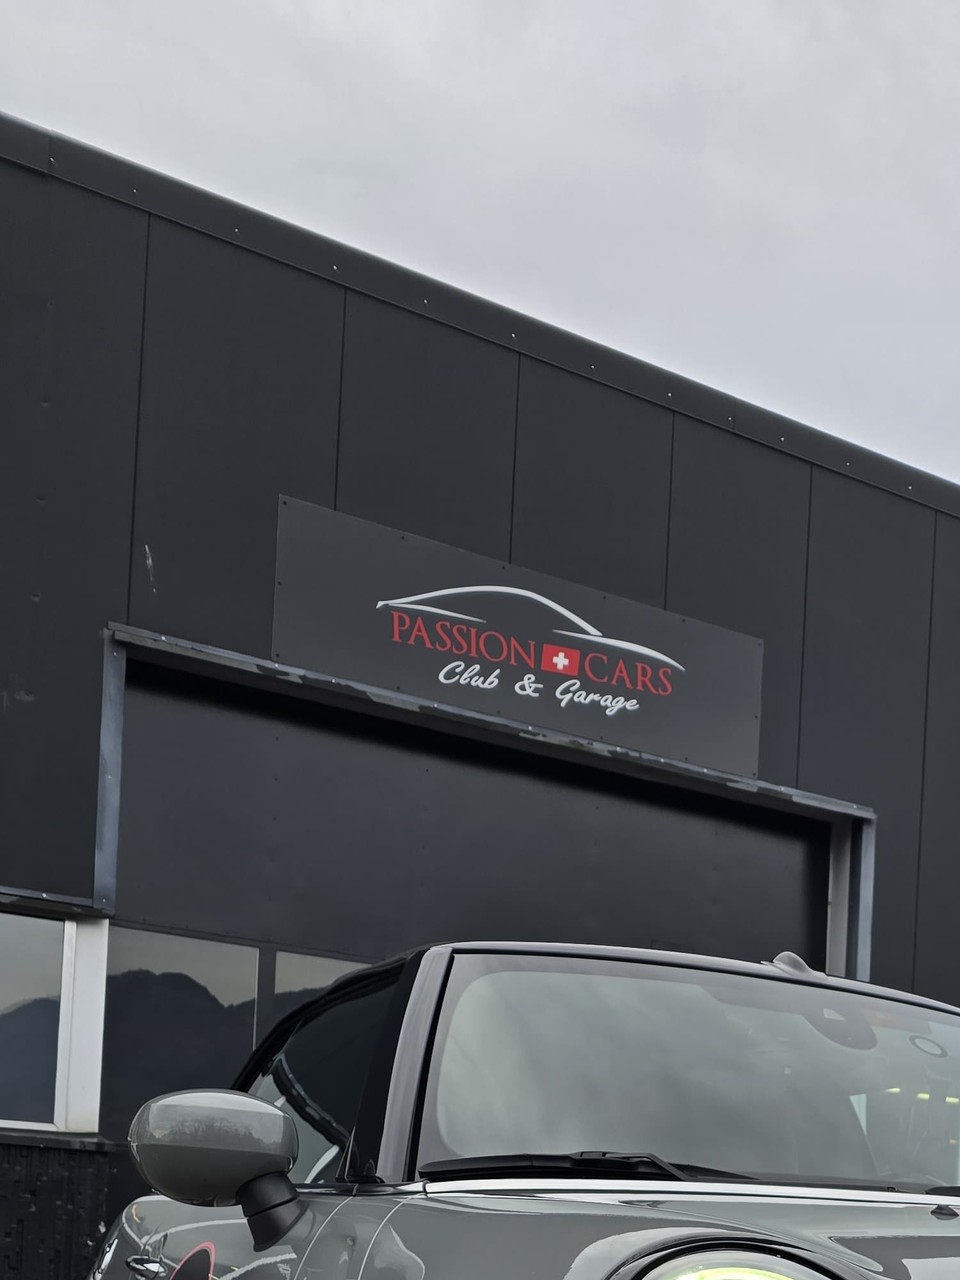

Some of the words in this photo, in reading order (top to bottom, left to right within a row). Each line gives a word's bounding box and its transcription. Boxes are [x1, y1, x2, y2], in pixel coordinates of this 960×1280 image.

[390, 611, 536, 669] PASSION
[584, 653, 673, 696] CARS
[438, 661, 500, 689] Club
[514, 673, 544, 697] &
[555, 679, 640, 716] Garage
